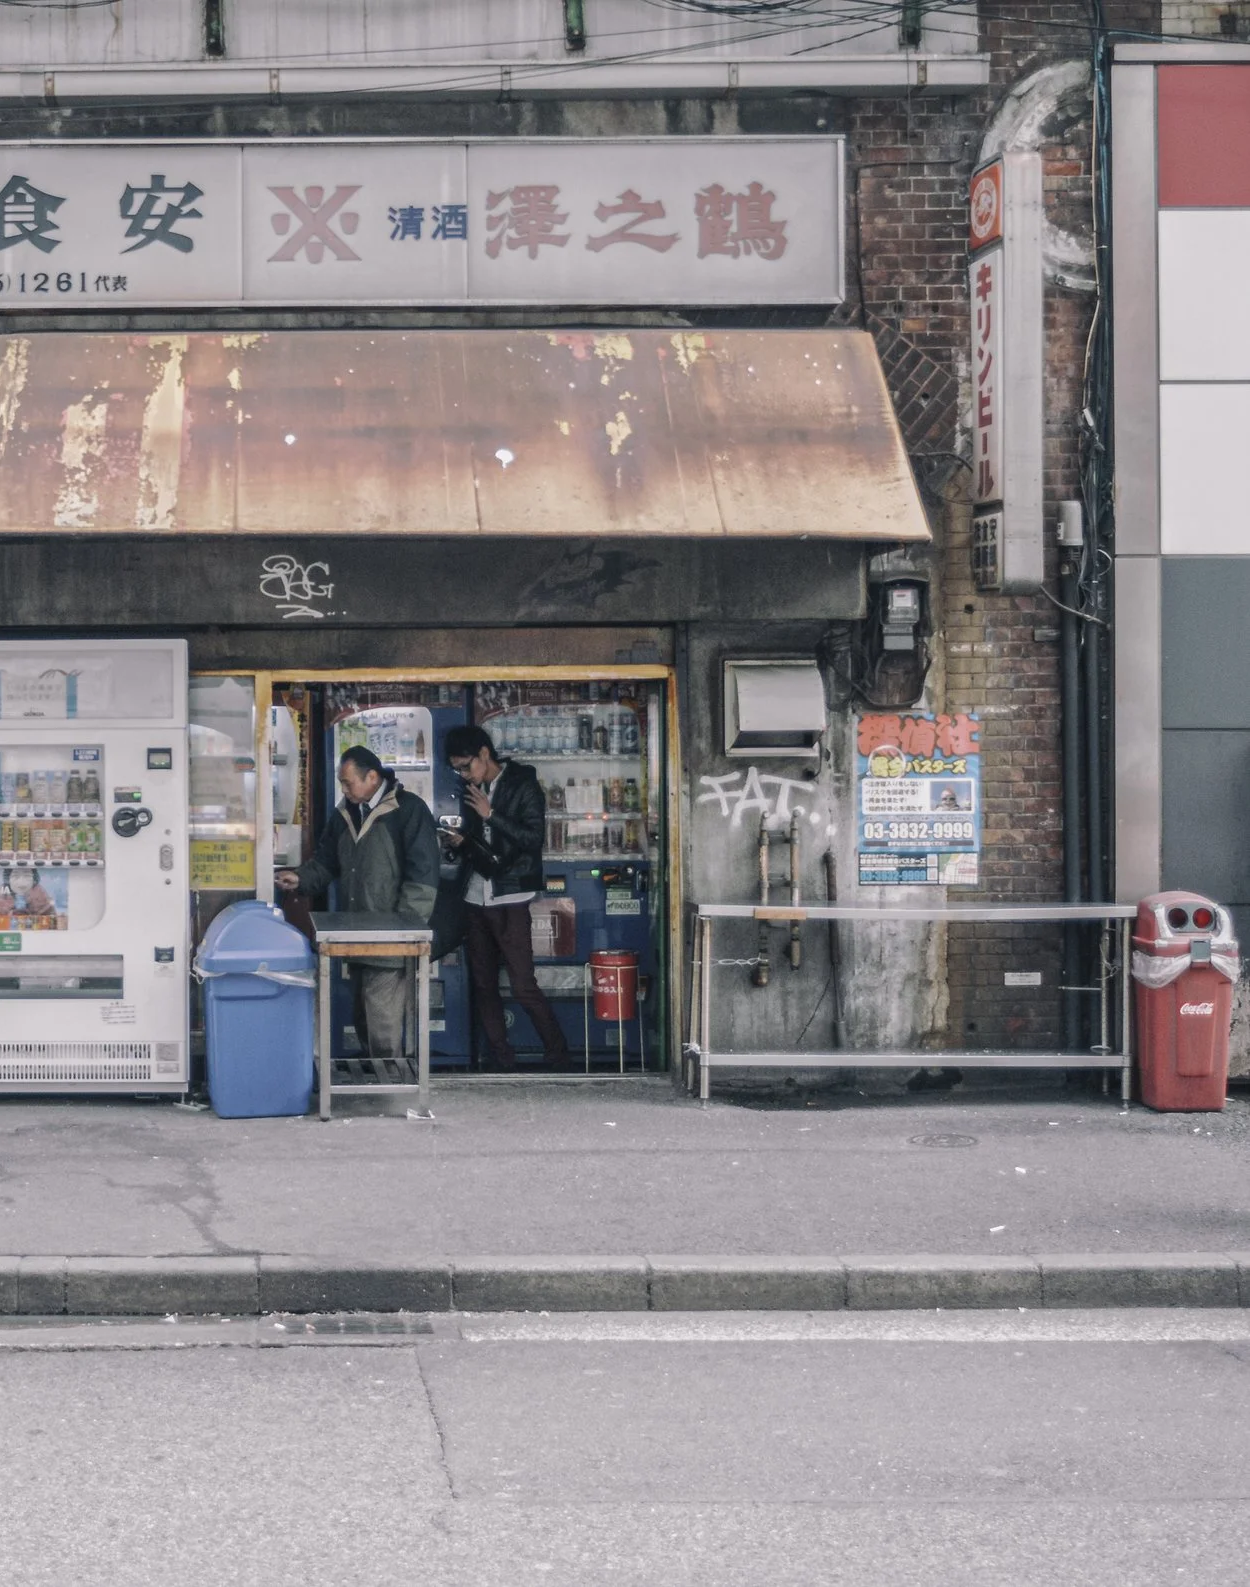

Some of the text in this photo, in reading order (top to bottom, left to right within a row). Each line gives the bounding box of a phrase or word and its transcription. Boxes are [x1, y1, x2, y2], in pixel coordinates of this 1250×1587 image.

[388, 204, 468, 241] 清酒
[975, 263, 995, 499] キリンビール
[857, 712, 981, 758] 探偵社
[863, 822, 974, 839] 03-3832-9999
